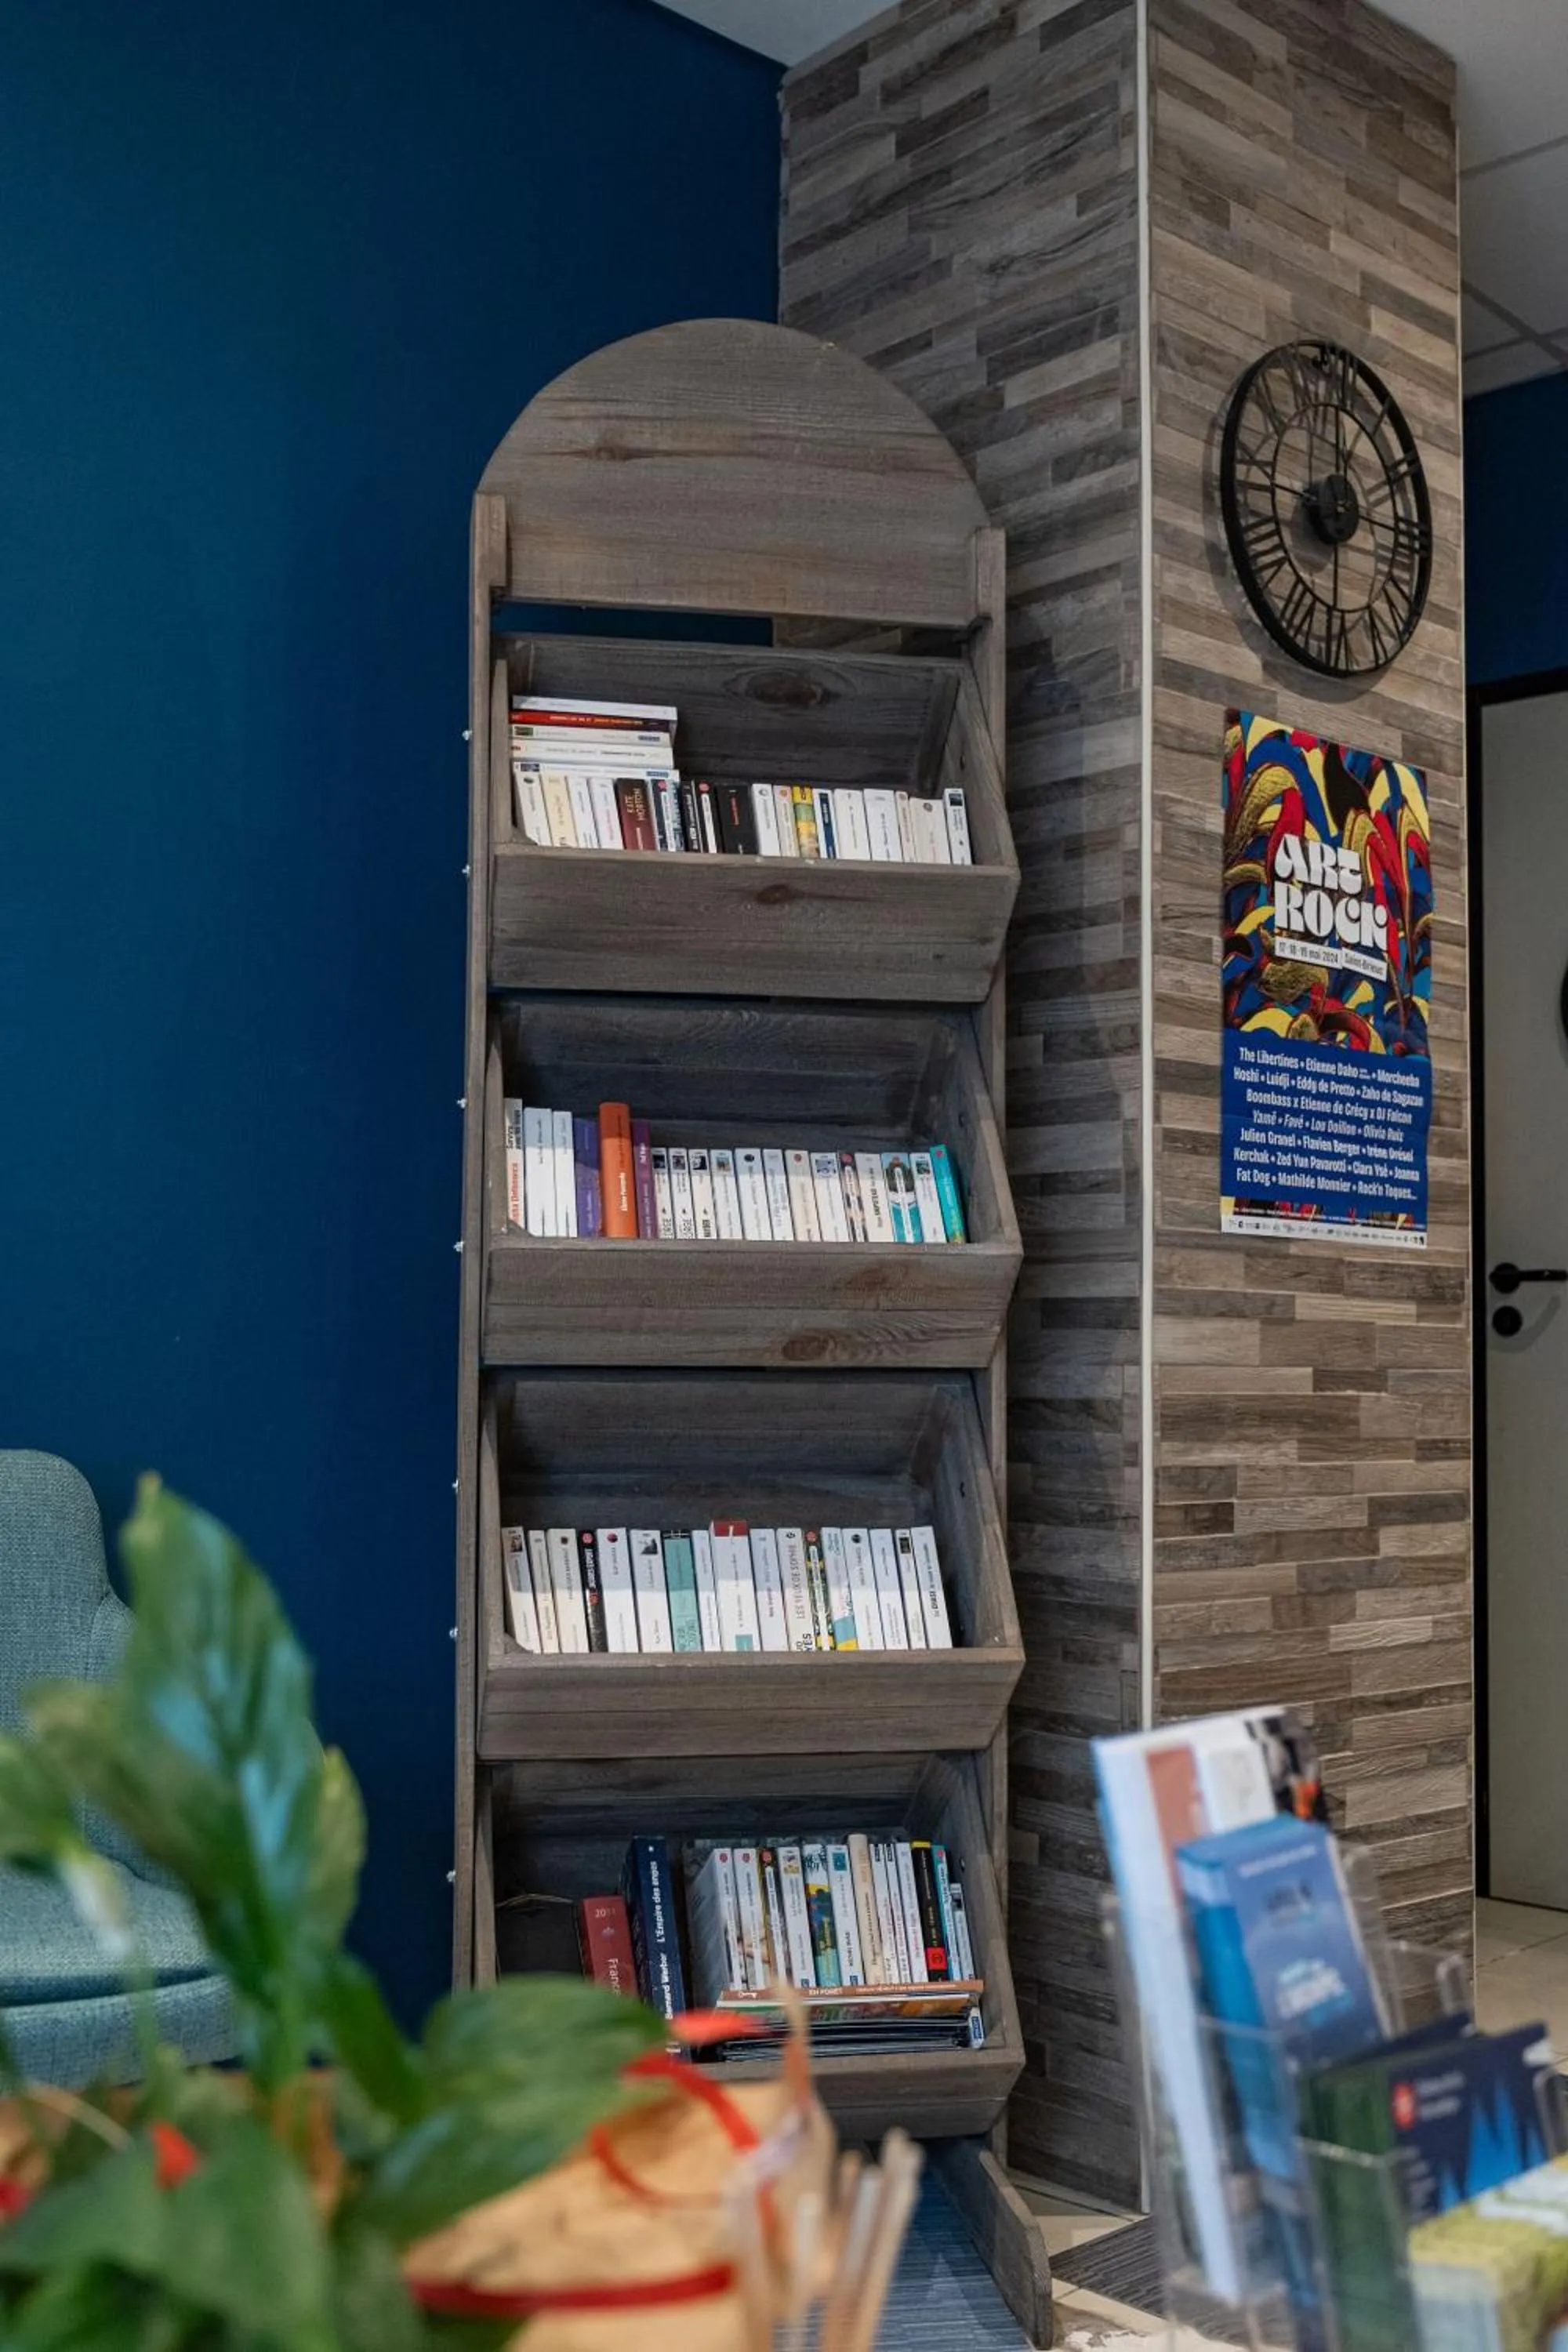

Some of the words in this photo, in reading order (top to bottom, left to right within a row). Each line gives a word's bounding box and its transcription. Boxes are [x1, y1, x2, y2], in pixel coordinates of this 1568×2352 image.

[1274, 880, 1389, 950] ROCK
[1309, 948, 1320, 960] mai
[1323, 951, 1338, 964] 2024
[1239, 1047, 1254, 1062] The
[1257, 1051, 1298, 1069] Libertines
[1338, 1065, 1358, 1078] Daho
[1234, 1067, 1259, 1083] Hoshi
[1297, 1076, 1317, 1094] Eddy
[1319, 1081, 1328, 1093] de
[1362, 1086, 1380, 1099] Zaho
[1381, 1088, 1391, 1101] de
[1247, 1089, 1291, 1107] Boombass
[1333, 1100, 1343, 1112] de
[1377, 1107, 1385, 1119] DJ
[1387, 1110, 1412, 1124] Falcon
[1240, 1127, 1265, 1144] Julien
[1268, 1131, 1295, 1147] Granel
[1303, 1137, 1332, 1152] Flavien
[1334, 1139, 1360, 1157] Berger
[1311, 1117, 1325, 1132] Lou
[1363, 1125, 1386, 1140] Olivia
[1388, 1127, 1404, 1142] Ruiz
[1234, 1148, 1269, 1163] Kerchak
[1276, 1152, 1292, 1166] Zed
[1294, 1154, 1309, 1167] Yun
[1352, 1162, 1373, 1175] Clara
[1236, 1167, 1251, 1183] Fat
[1252, 1169, 1270, 1187] Dog
[1278, 1172, 1316, 1189] Mathilde
[1316, 1176, 1351, 1192] Monnier
[649, 1860, 660, 1886] anges
[652, 1888, 662, 1904] des
[654, 1904, 666, 1943] L'Empire
[659, 1953, 670, 1984] Werber
[662, 1984, 673, 2020] Bernard
